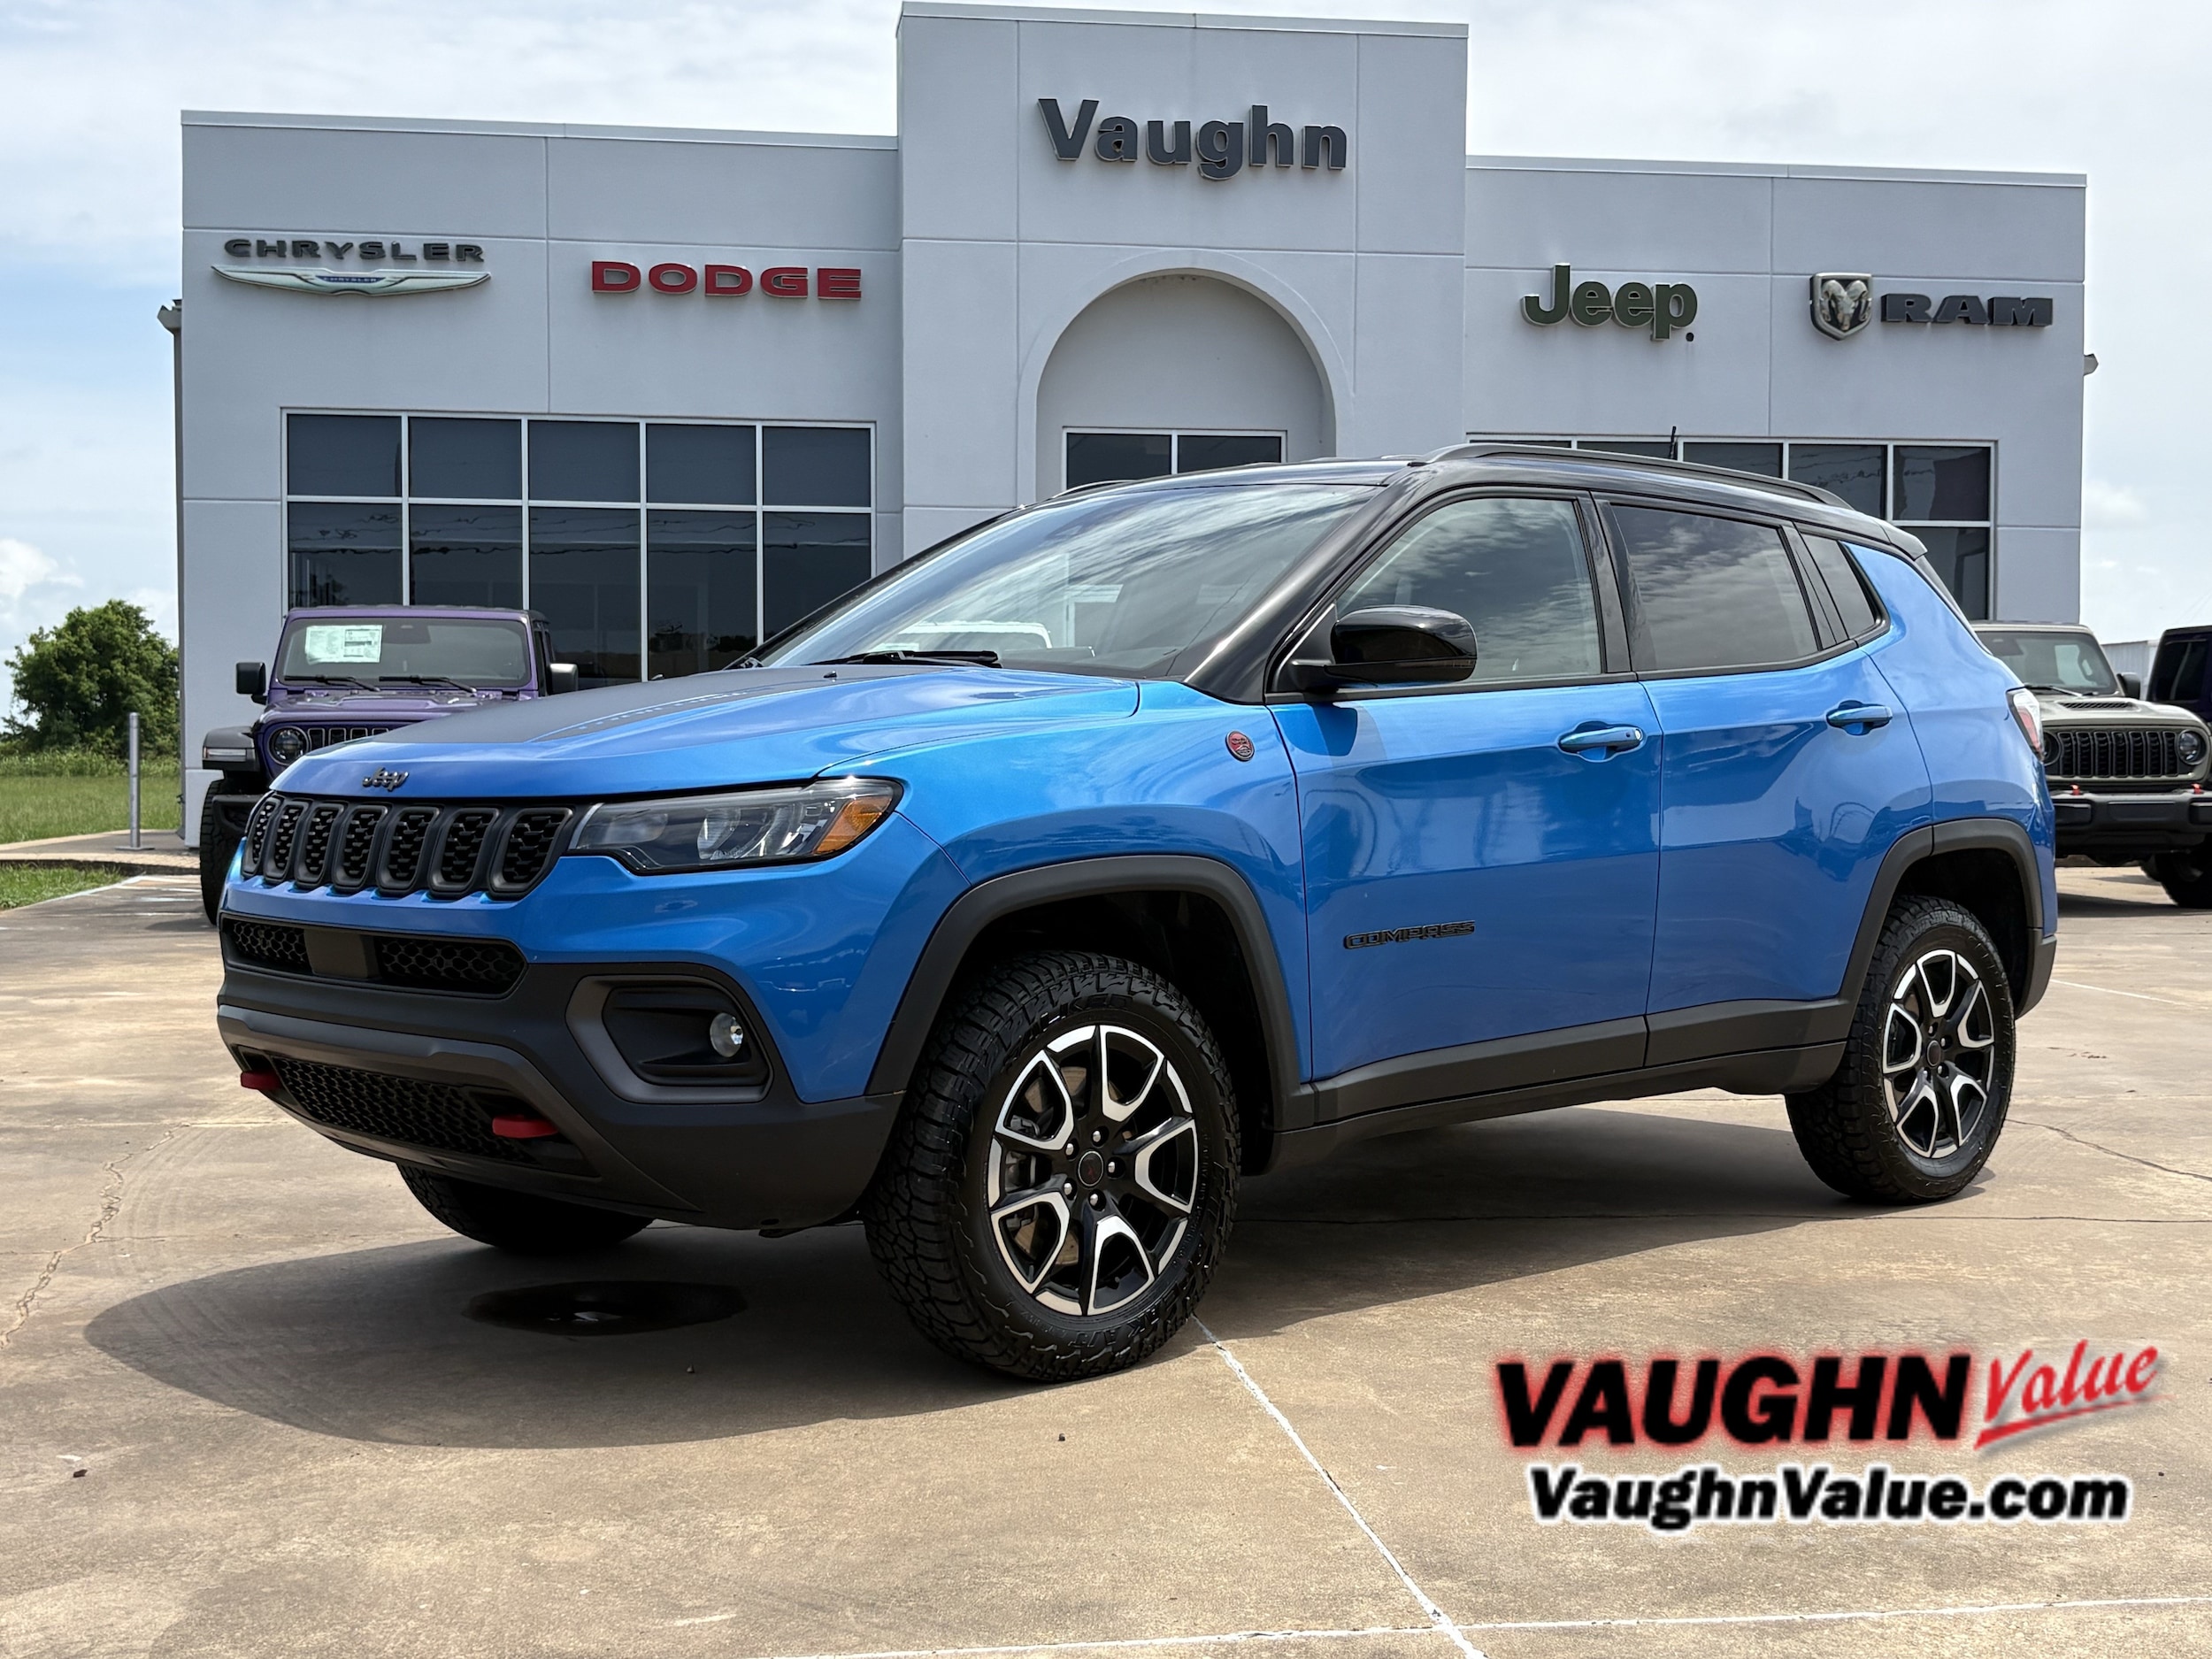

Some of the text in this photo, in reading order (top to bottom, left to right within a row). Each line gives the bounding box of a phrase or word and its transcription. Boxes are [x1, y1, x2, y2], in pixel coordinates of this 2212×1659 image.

[1037, 97, 1348, 180] Vaughn
[224, 237, 485, 263] CHRYSLER
[591, 260, 863, 301] DODGE
[1521, 263, 1698, 342] Jeep
[1881, 293, 2054, 328] RAM
[362, 766, 410, 792] Jeep
[1343, 919, 1476, 949] COMPASS
